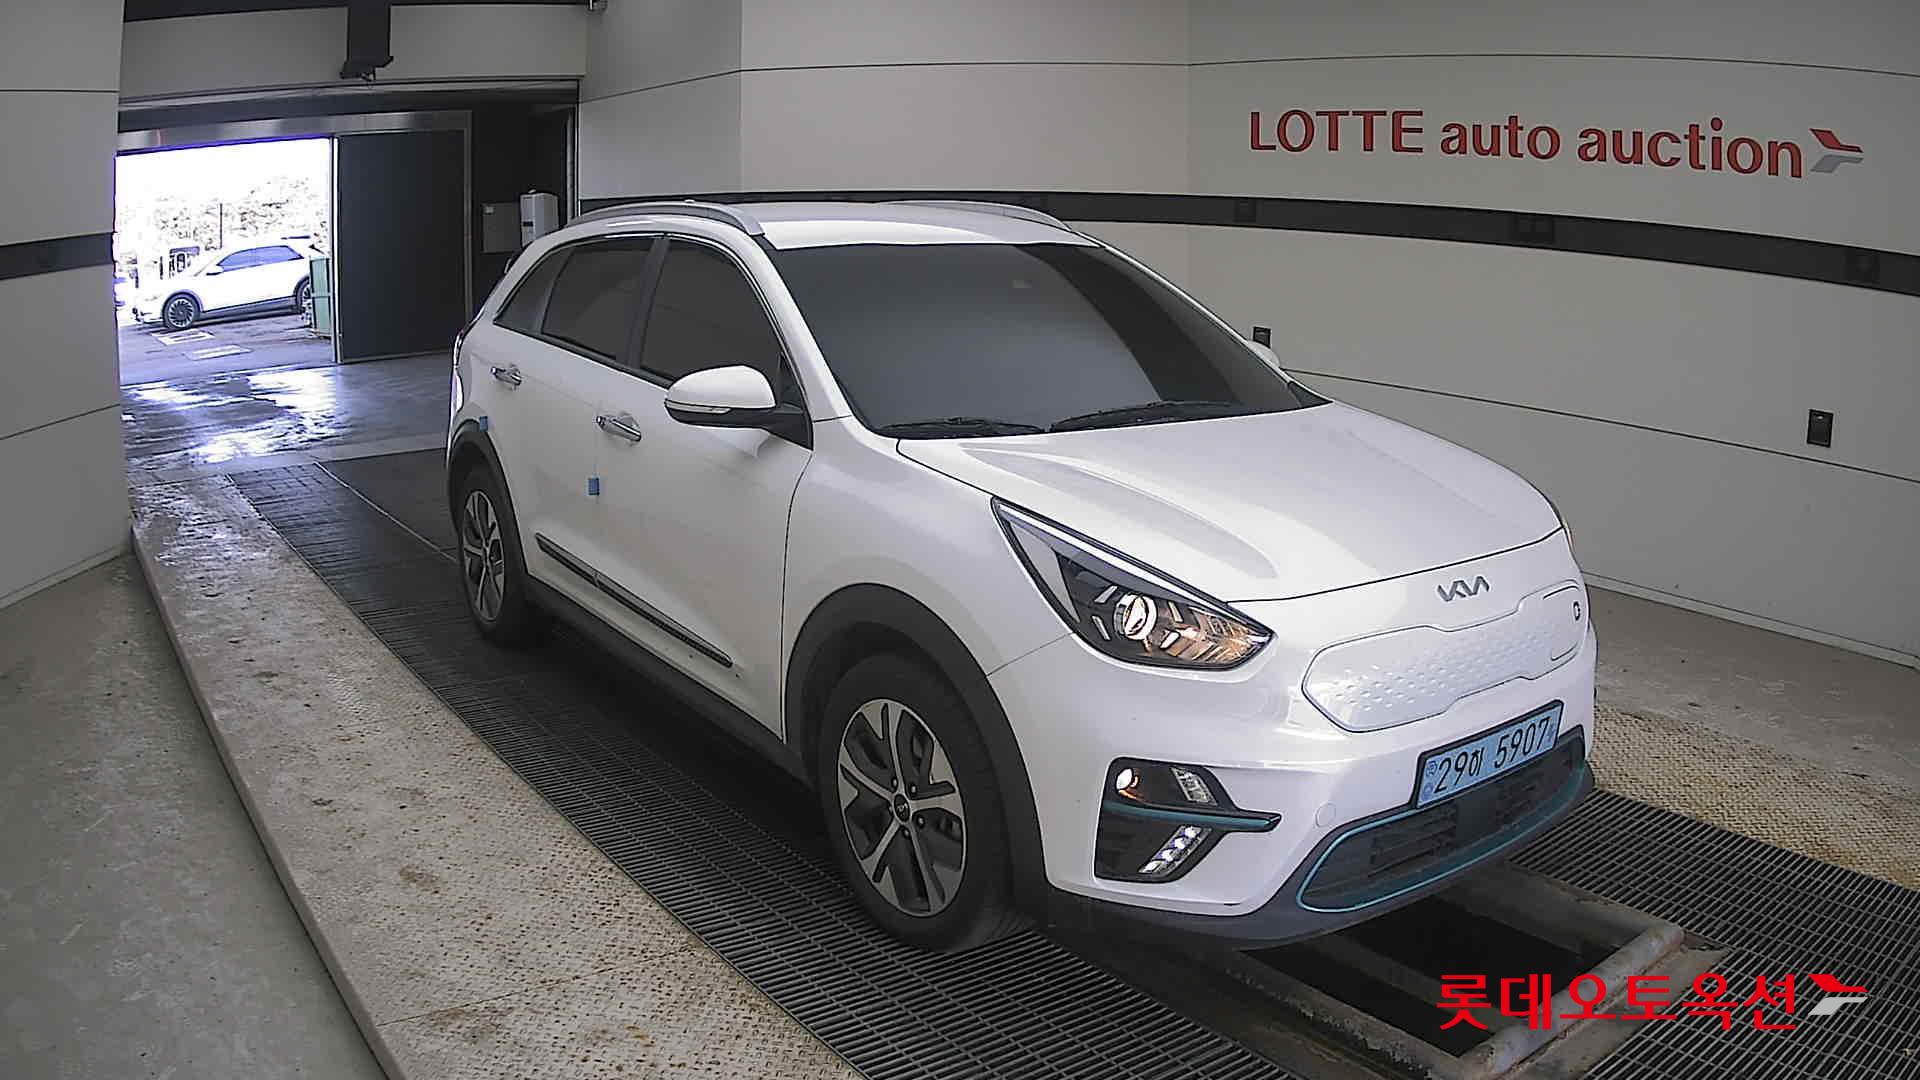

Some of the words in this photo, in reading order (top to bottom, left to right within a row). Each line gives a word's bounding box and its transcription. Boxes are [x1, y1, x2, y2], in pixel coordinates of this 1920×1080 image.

[1250, 110, 1424, 153] LOTTE
[1440, 115, 1561, 160] auto
[1577, 117, 1803, 178] auction
[1494, 716, 1552, 769] 5907
